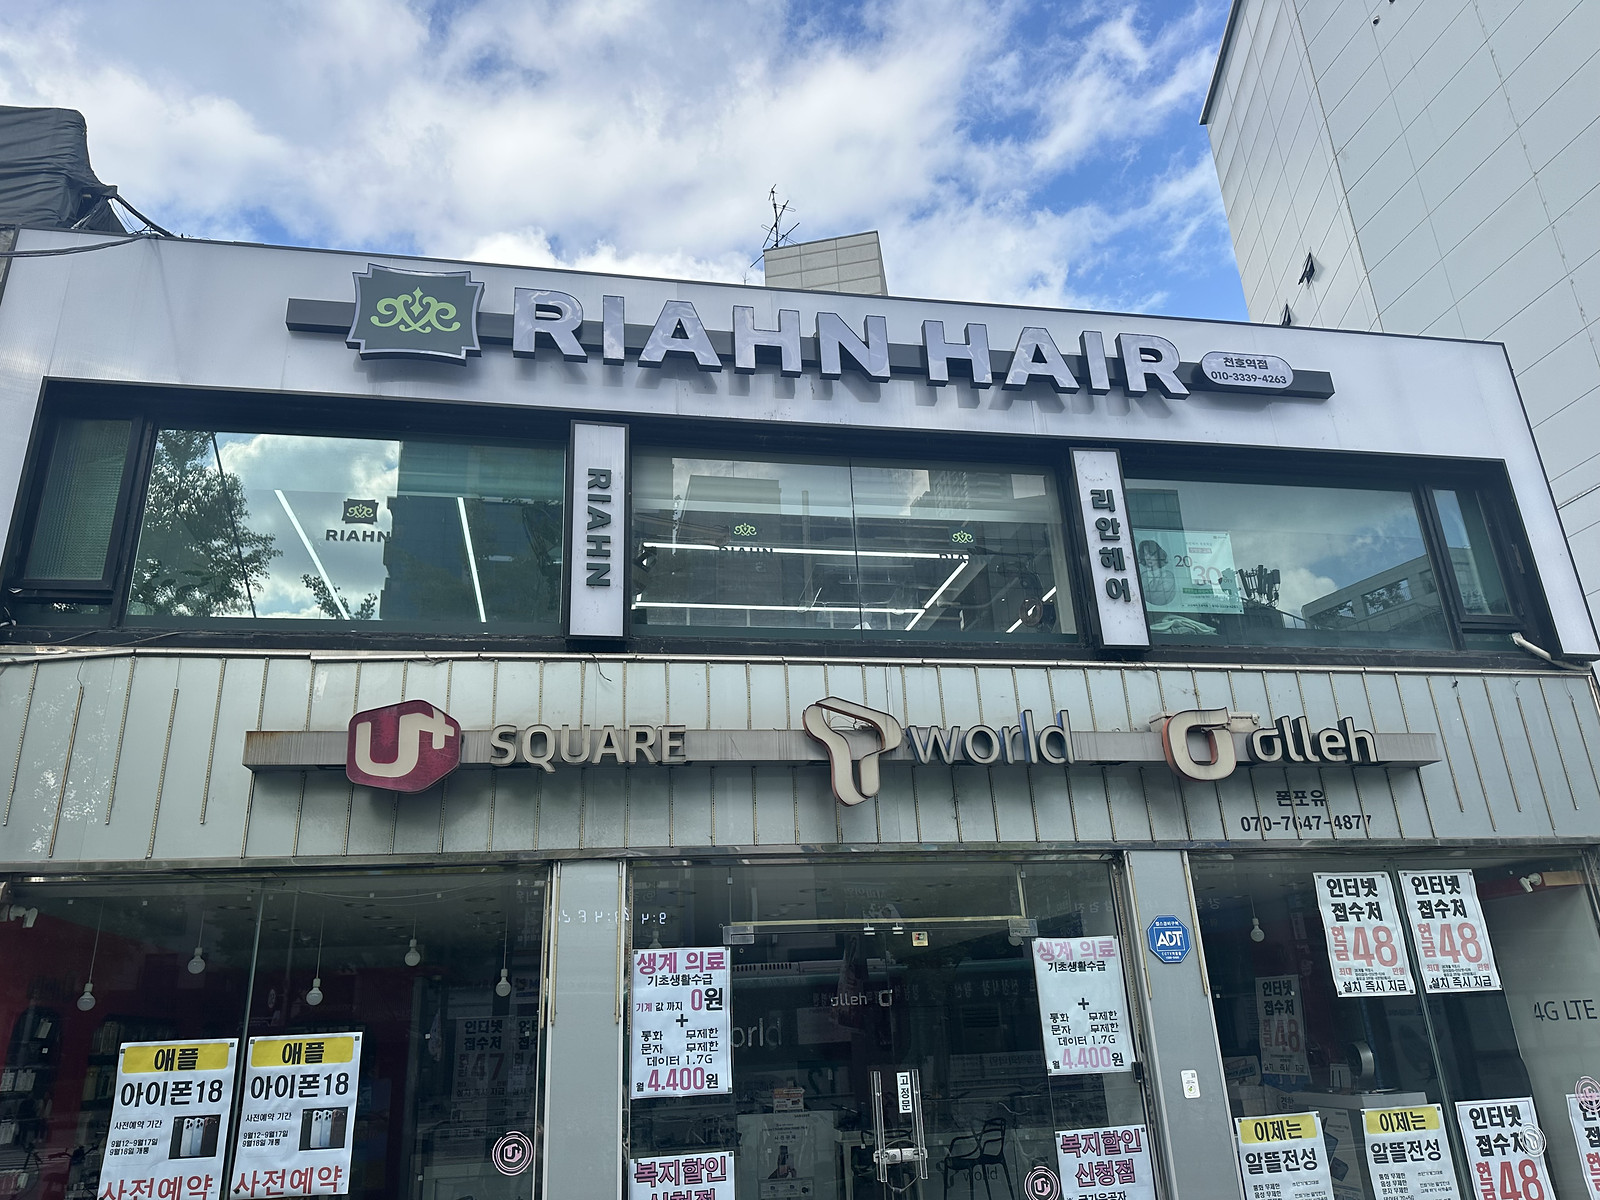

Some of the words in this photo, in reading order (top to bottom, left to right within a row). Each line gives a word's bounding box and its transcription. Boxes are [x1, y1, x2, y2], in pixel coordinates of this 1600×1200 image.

[513, 286, 890, 383] RIAHN
[920, 319, 1191, 399] HAIR
[1223, 357, 1269, 370] 천호역점
[1211, 370, 1287, 384] 010-3339-4263
[325, 529, 391, 543] RIAHN
[586, 467, 612, 588] RIAHN
[1090, 488, 1132, 603] 리안헤어
[907, 709, 1075, 766] world
[1245, 715, 1379, 764] olleh
[488, 723, 687, 775] SQUARE
[1275, 790, 1326, 807] 폰포유
[1325, 877, 1379, 898] 인터넷
[1410, 875, 1461, 896] 인터넷
[1331, 901, 1383, 922] 접수처
[1417, 899, 1468, 919] 접수처
[1156, 930, 1183, 947] ADT
[1351, 926, 1399, 968] 48
[1438, 922, 1483, 964] 48
[1037, 941, 1074, 962] 생계
[1080, 940, 1116, 961] 의료
[636, 952, 678, 975] 생계
[685, 951, 726, 973] 의료
[1048, 961, 1107, 973] 기초생활수급
[647, 974, 714, 987] 기초생활수급
[1343, 980, 1363, 993] 설치
[1365, 980, 1386, 993] 즉시
[1388, 979, 1407, 992] 지급
[1431, 976, 1450, 989] 설치
[1453, 976, 1471, 988] 즉시
[1474, 975, 1492, 987] 지급
[635, 1001, 653, 1013] 기계
[655, 1001, 664, 1012] 값
[666, 1001, 683, 1012] 까지
[690, 987, 724, 1012] 0원
[1534, 1000, 1560, 1022] 4G
[1565, 999, 1598, 1021] LTE
[1049, 1012, 1069, 1023] 통화
[1088, 1011, 1118, 1022] 무제한
[641, 1030, 664, 1042] 통화
[685, 1028, 719, 1040] 무제한
[730, 1017, 783, 1049] orld
[1051, 1025, 1071, 1036] 문자
[1090, 1023, 1119, 1034] 무제한
[1057, 1035, 1088, 1046] 데이터
[1091, 1034, 1116, 1045] 1.7G
[281, 1042, 325, 1065] 애플
[641, 1043, 664, 1055] 문자
[685, 1041, 719, 1053] 무제한
[153, 1047, 199, 1072] 애플
[646, 1055, 681, 1067] 데이터
[685, 1054, 713, 1066] 1.7G
[120, 1079, 223, 1108] 아이폰18
[250, 1072, 349, 1101] 아이폰18
[636, 1082, 645, 1093] 월
[900, 1074, 911, 1112] 고정문
[114, 1120, 145, 1130] 사전예약
[147, 1120, 163, 1129] 기간
[245, 1112, 275, 1123] 사전예약
[277, 1112, 292, 1121] 기간
[1379, 1112, 1426, 1132] 이제는
[1468, 1104, 1522, 1130] 인터넷
[1253, 1121, 1303, 1142] 이제는
[1061, 1128, 1143, 1159] 복지할인
[235, 1165, 343, 1198] 사전예약
[634, 1155, 727, 1188] 복지할인
[1075, 1158, 1136, 1188] 신청점
